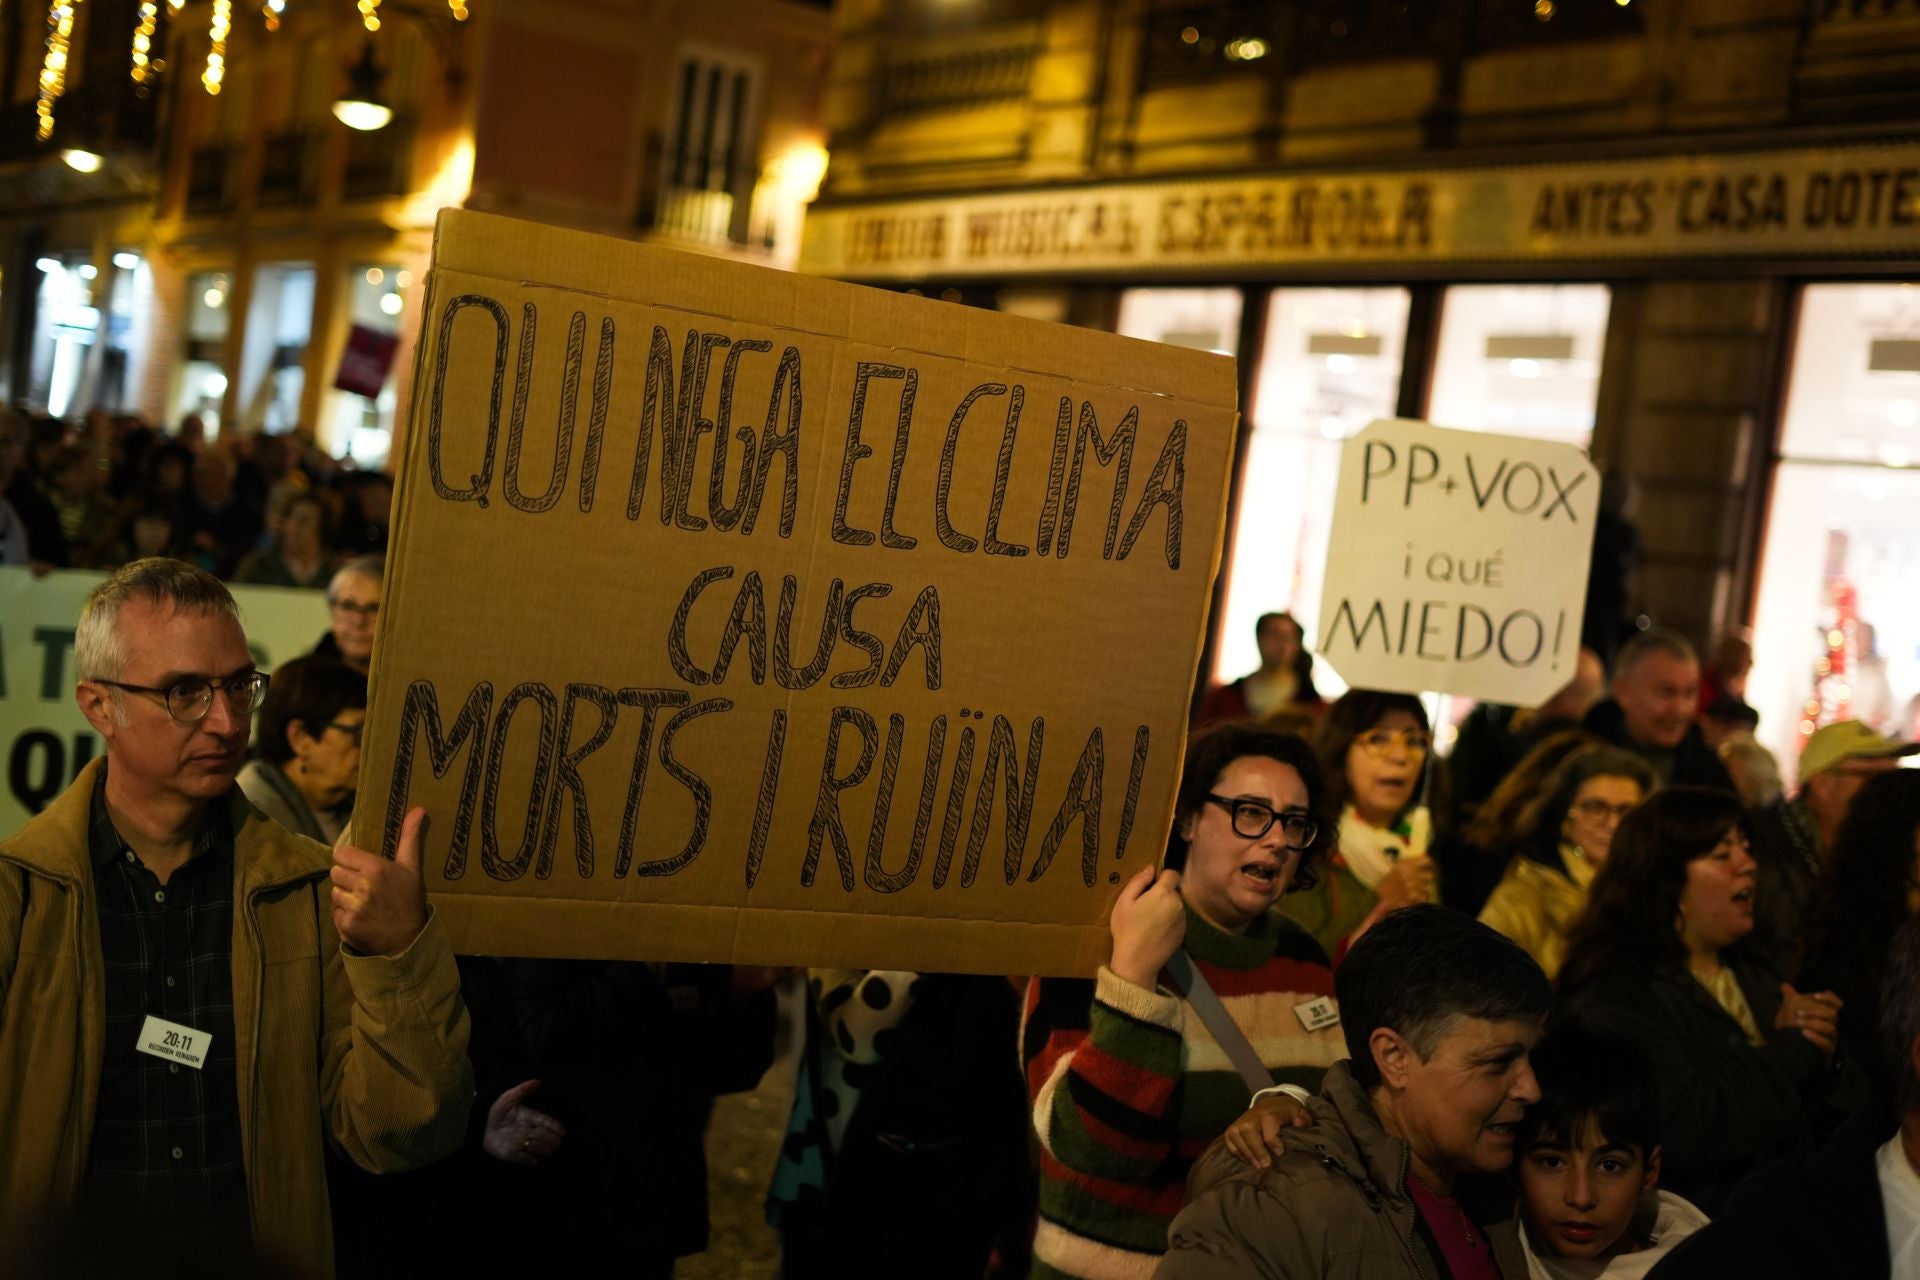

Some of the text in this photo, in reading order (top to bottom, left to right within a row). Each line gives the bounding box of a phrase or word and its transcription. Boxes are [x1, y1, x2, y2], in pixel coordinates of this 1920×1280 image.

[1529, 182, 1655, 239] ANTES
[429, 295, 1188, 570] QUI NEGA EL CLIMA
[668, 566, 942, 690] CAUSA
[1322, 598, 1565, 672] MIEDO!
[382, 680, 1150, 894] MORTS I RUÏNA!
[163, 1030, 192, 1051] 20:11
